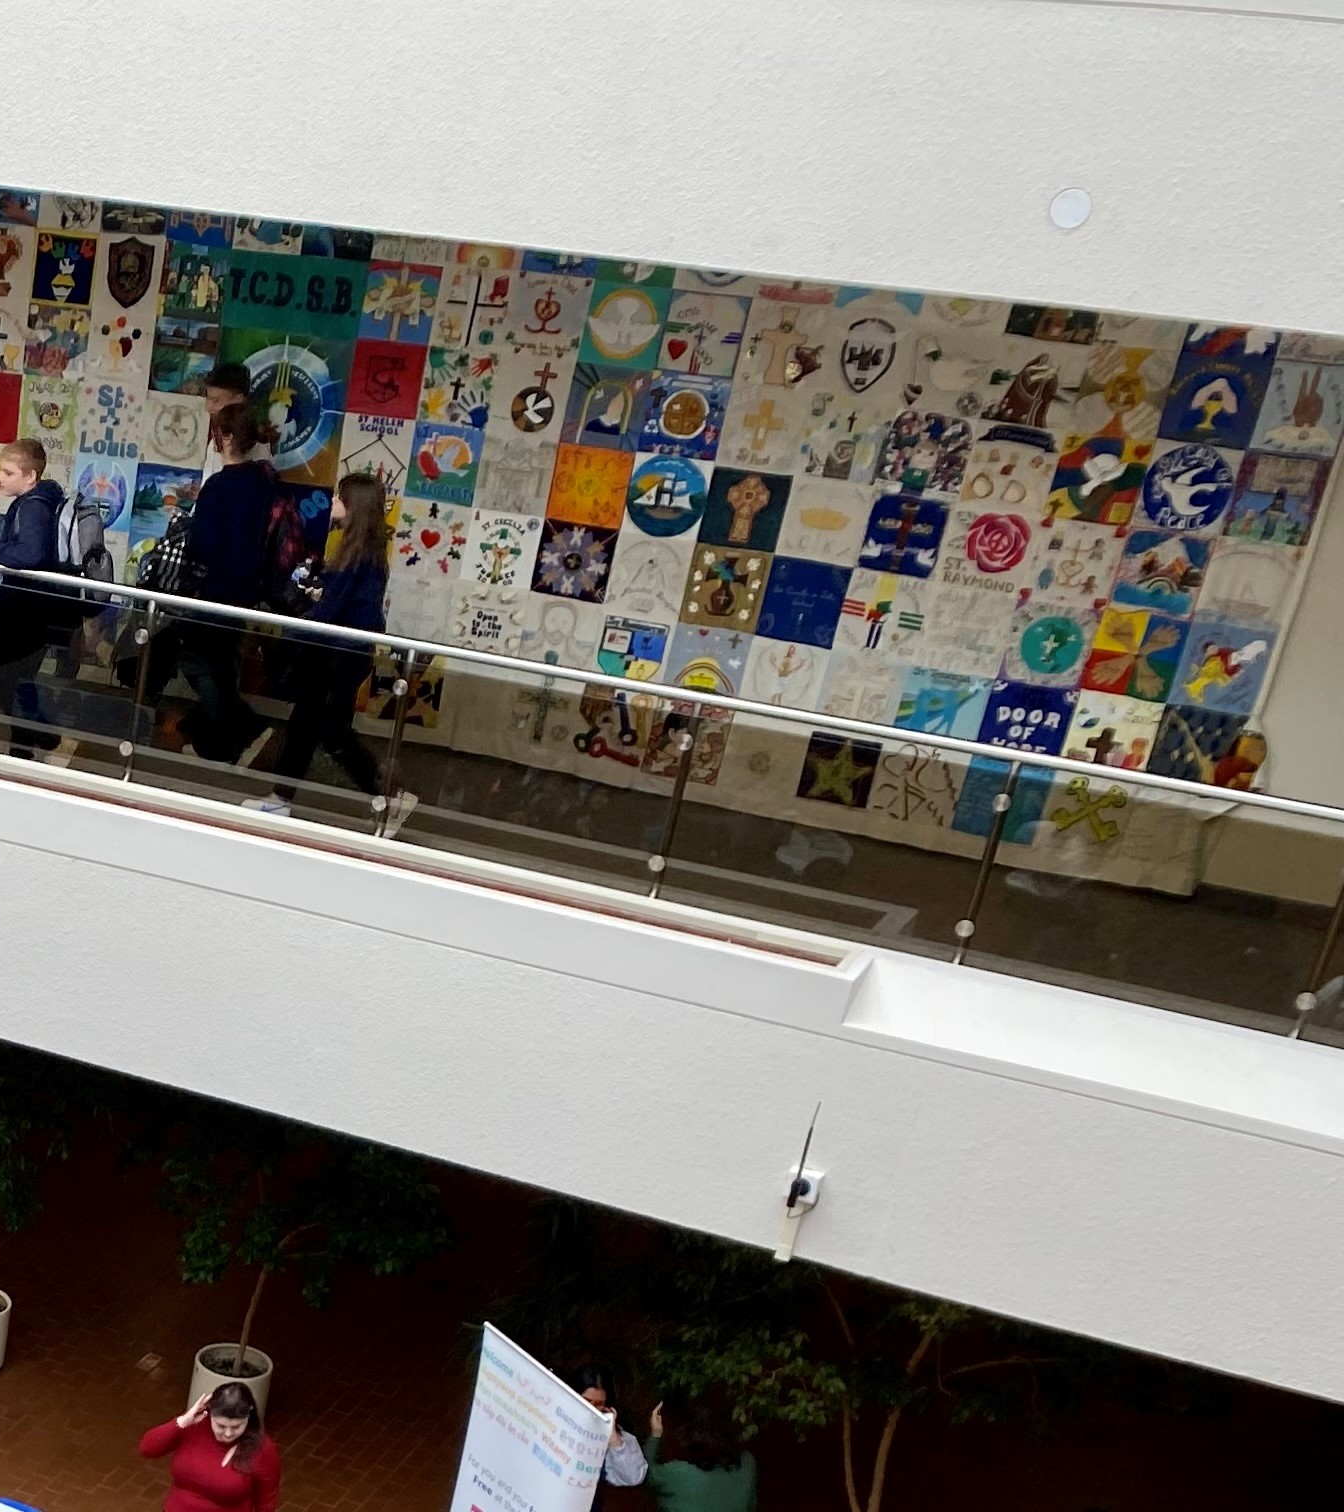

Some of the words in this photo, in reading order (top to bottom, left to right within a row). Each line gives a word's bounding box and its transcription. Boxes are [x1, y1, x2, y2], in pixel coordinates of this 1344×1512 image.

[229, 267, 358, 318] T.C.D.S.B.
[359, 424, 399, 436] SCHOOL
[373, 416, 405, 428] HELEN
[1157, 506, 1206, 530] Peace
[943, 571, 1015, 593] RAYMOND
[477, 610, 499, 623] Open
[487, 620, 502, 631] the
[471, 627, 500, 639] Spirit
[999, 705, 1061, 728] DOOR
[1009, 725, 1036, 740] OF
[472, 1474, 493, 1496] Free
[480, 1467, 496, 1482] you
[497, 1479, 513, 1495] and
